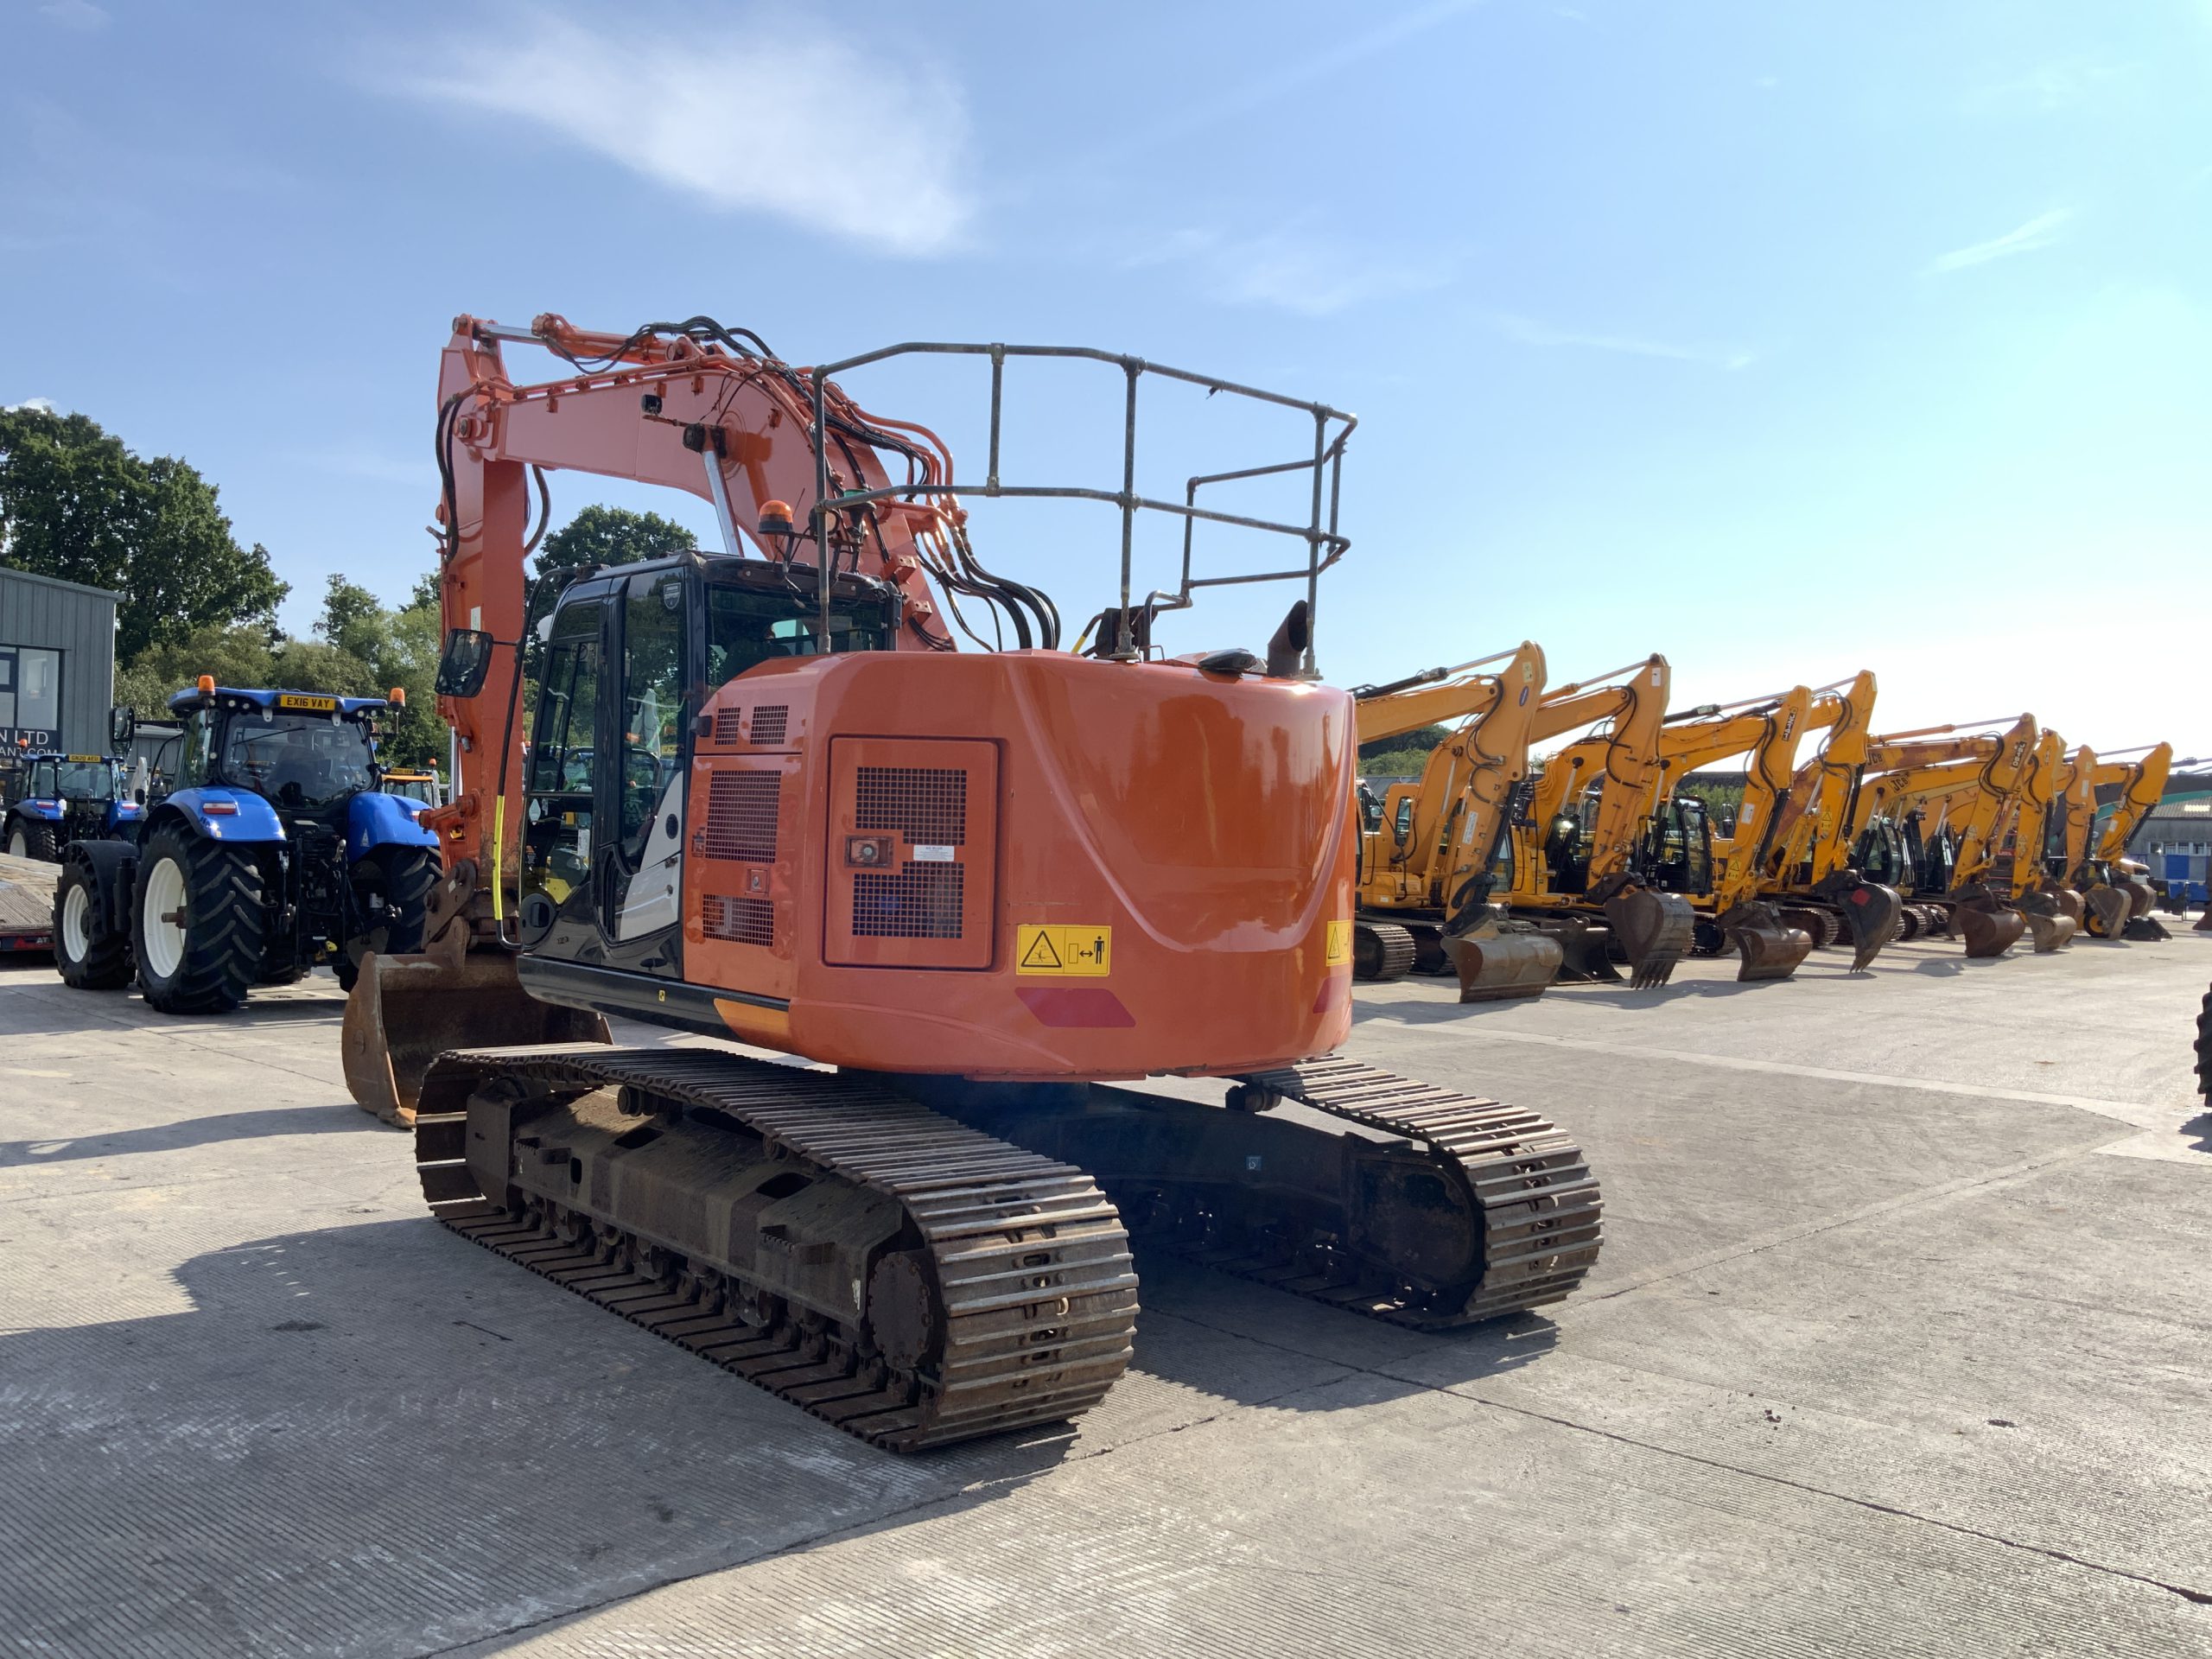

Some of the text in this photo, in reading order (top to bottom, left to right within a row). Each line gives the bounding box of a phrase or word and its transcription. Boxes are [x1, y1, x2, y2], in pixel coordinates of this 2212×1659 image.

[287, 696, 330, 709] EX16 VAY
[15, 730, 48, 745] LTD
[1867, 752, 1884, 766] JCB
[1891, 777, 1909, 791] JCB
